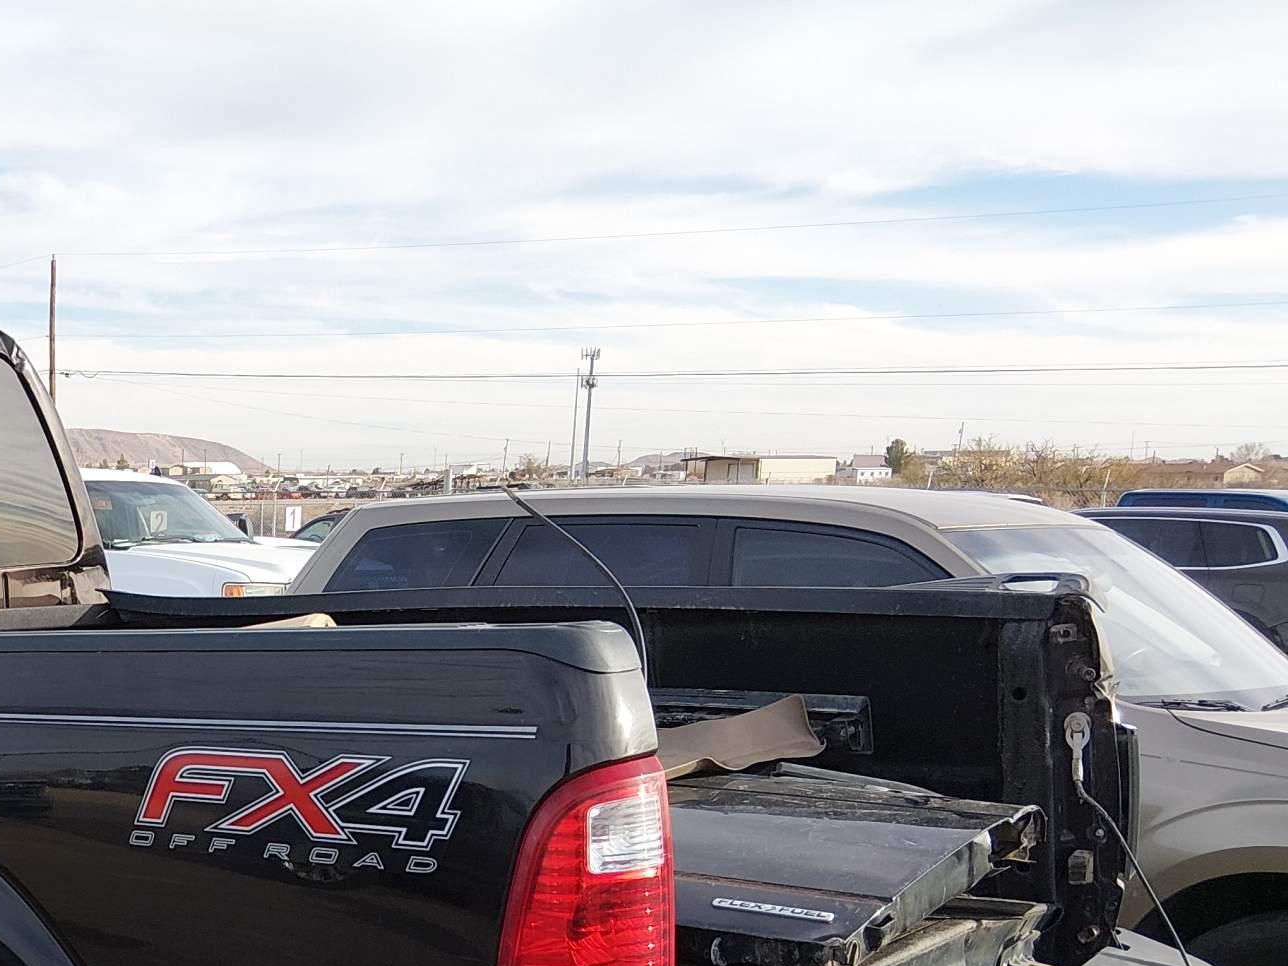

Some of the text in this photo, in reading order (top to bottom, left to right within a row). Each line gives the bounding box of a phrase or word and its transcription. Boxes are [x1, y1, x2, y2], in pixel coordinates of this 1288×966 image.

[134, 745, 471, 851] FX4
[128, 830, 439, 874] OFF ROAD
